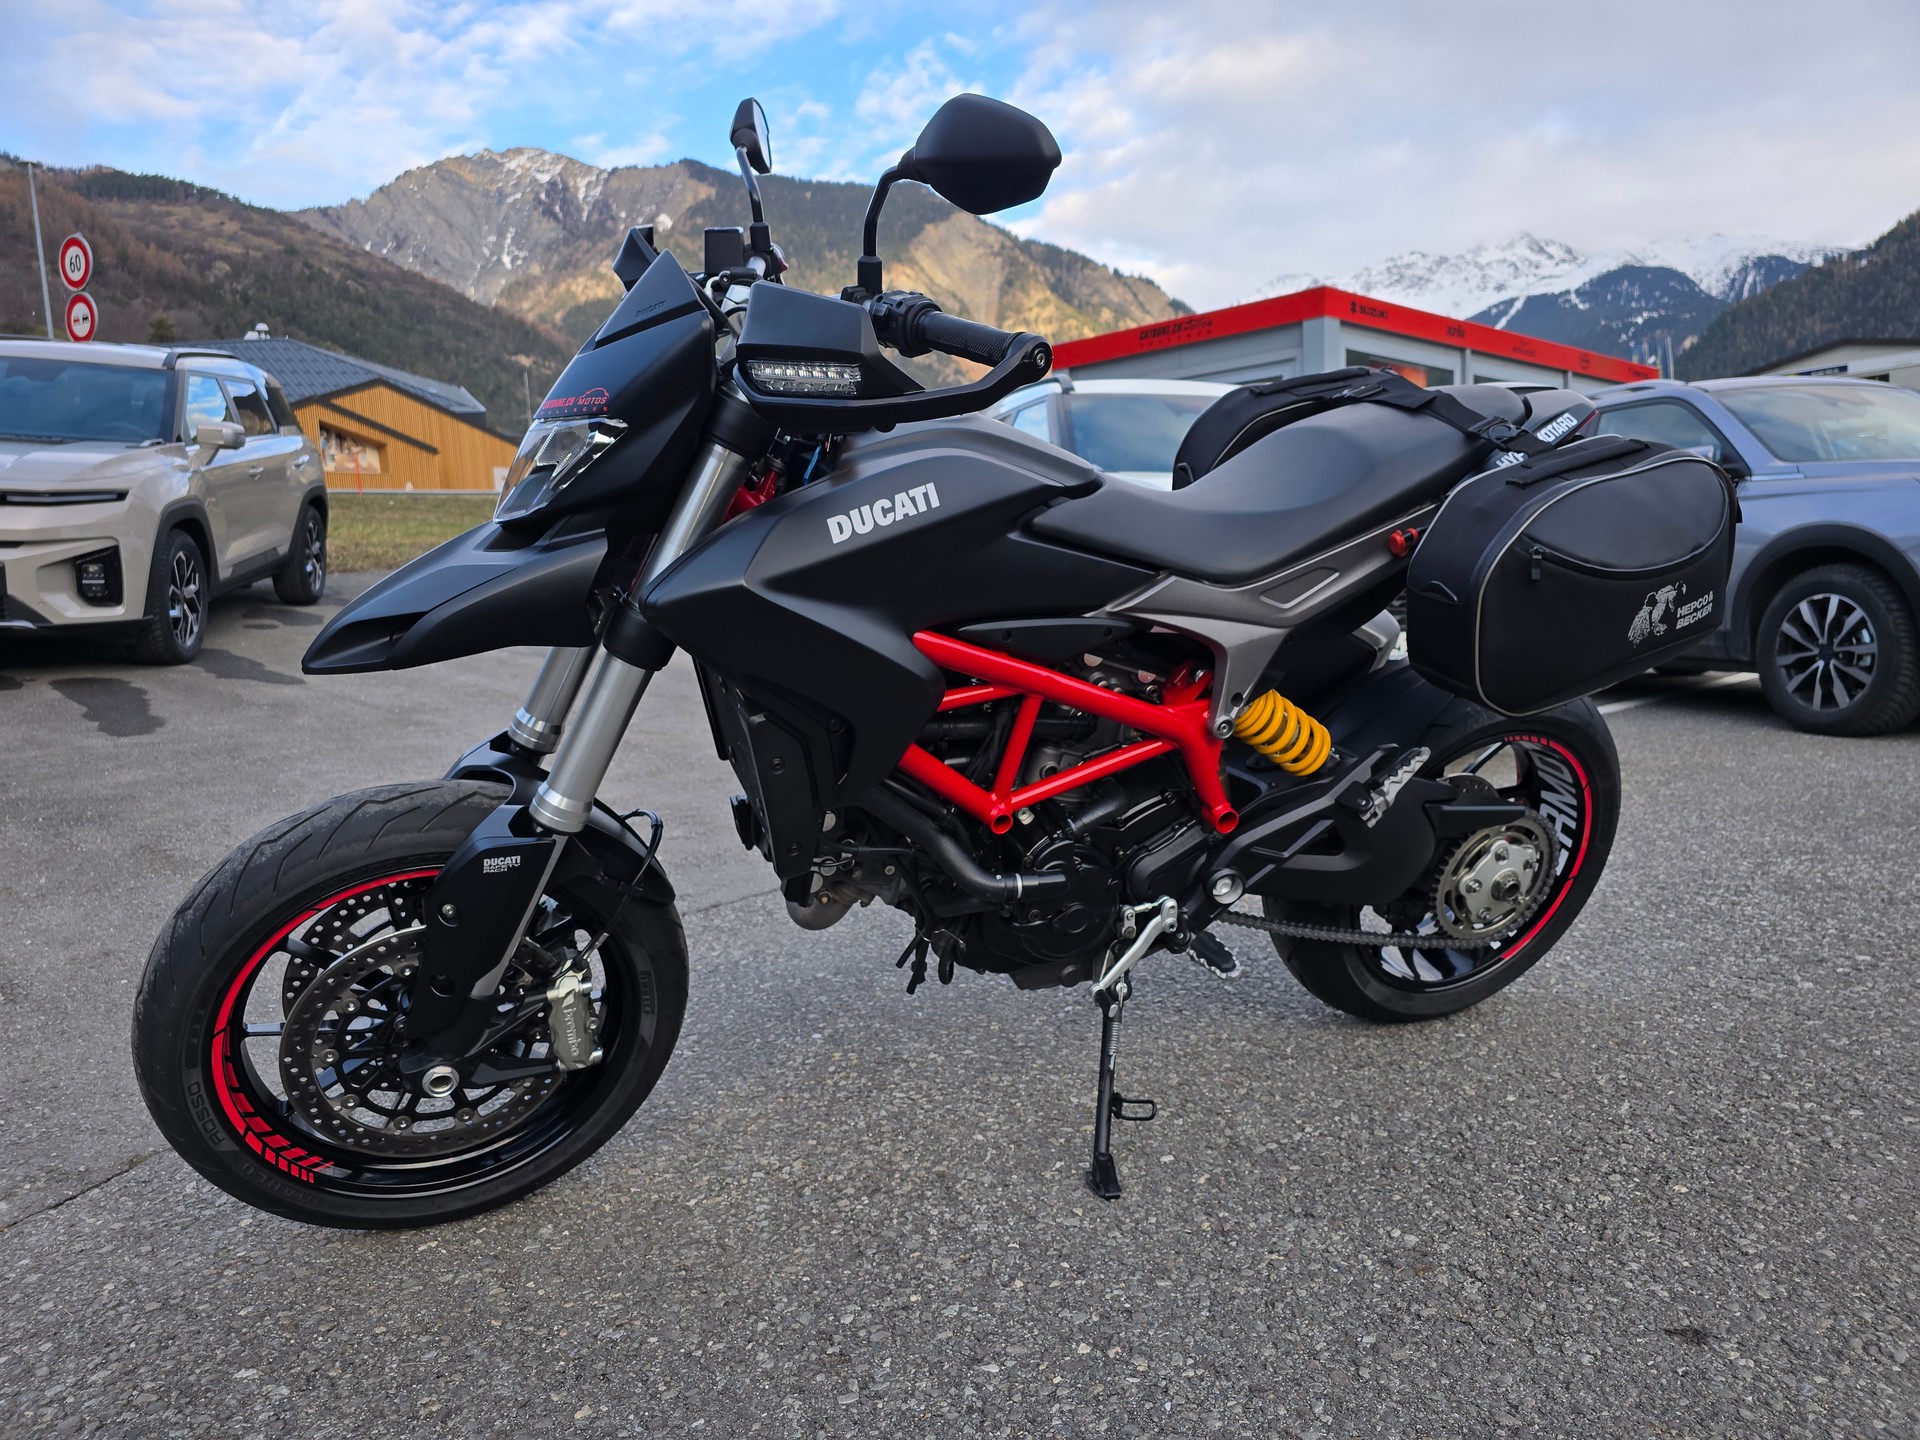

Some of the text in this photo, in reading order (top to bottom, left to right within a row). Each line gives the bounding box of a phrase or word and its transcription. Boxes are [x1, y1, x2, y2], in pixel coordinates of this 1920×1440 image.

[69, 254, 81, 273] 60
[1360, 304, 1388, 319] SUZUKI
[577, 396, 607, 405] MOTOS
[826, 482, 940, 544] DUCATI
[1676, 602, 1713, 630] BECKER
[483, 855, 521, 867] DUCATI
[563, 1008, 582, 1056] brembo
[187, 1081, 226, 1147] ROSSO
